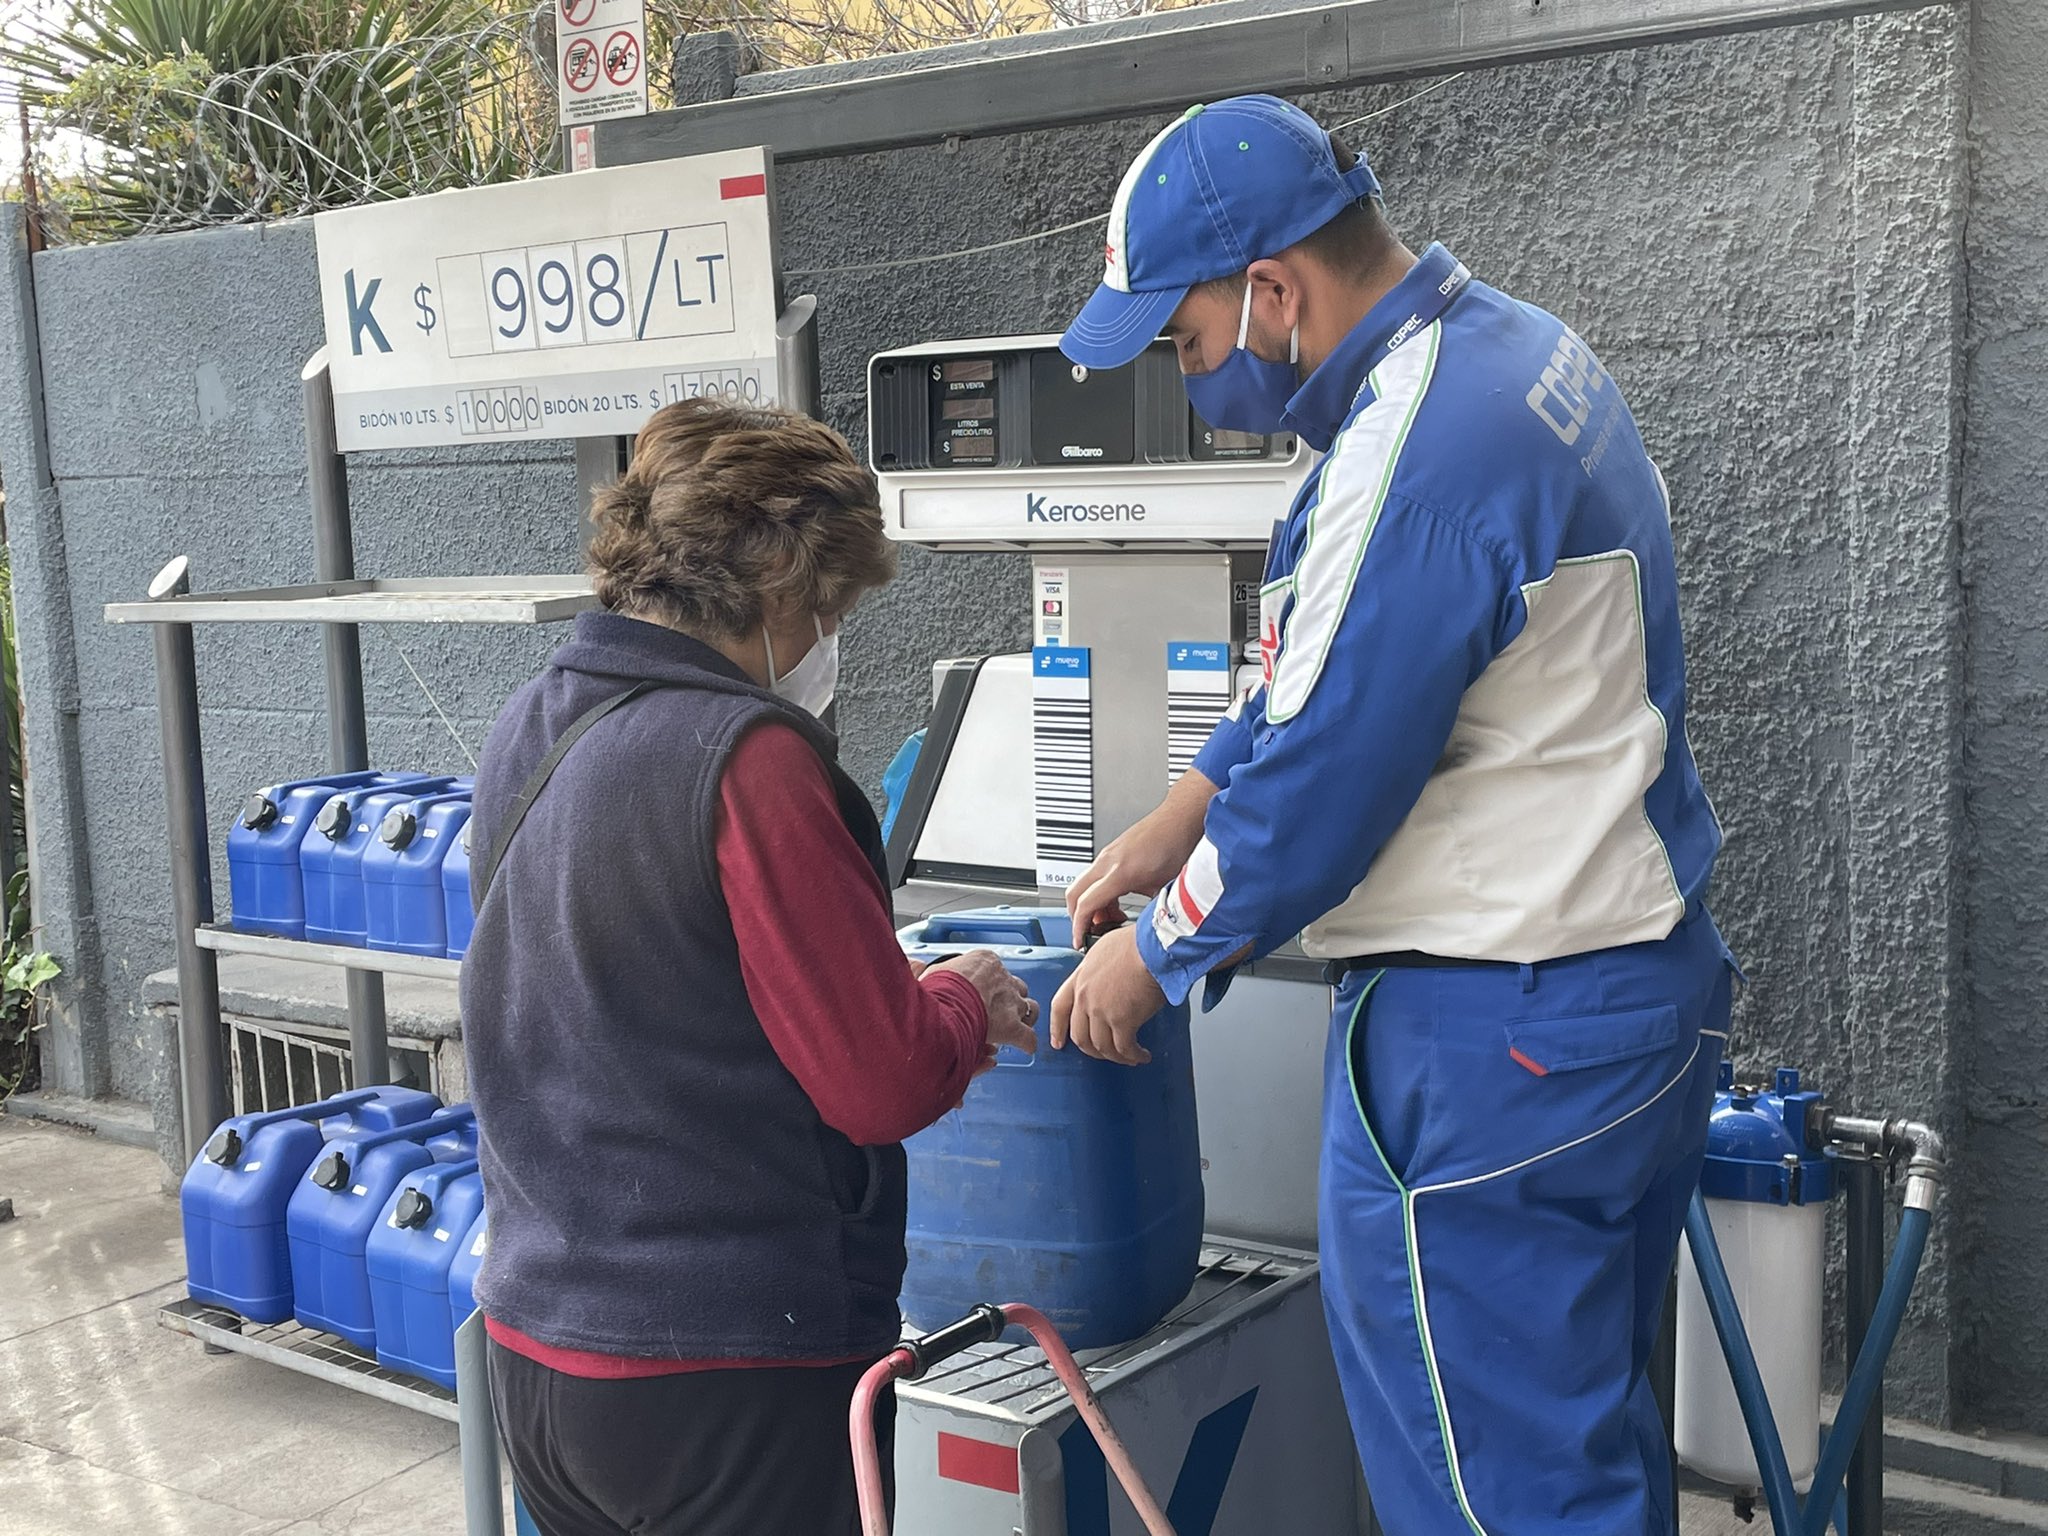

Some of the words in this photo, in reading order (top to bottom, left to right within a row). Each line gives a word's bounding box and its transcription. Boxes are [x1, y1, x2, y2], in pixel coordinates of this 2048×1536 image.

[343, 267, 394, 356] K
[414, 282, 437, 336] $
[1387, 313, 1423, 350] COPEC
[932, 364, 942, 381] $
[950, 382, 965, 390] ESTA
[965, 381, 985, 390] VENTA
[359, 407, 398, 429] BIDÓN
[399, 410, 413, 426] 10
[416, 408, 440, 425] LTS.
[445, 405, 455, 425] $
[461, 396, 539, 424] 10000
[544, 395, 589, 416] BIDÓN
[593, 396, 610, 412] 20
[614, 394, 643, 411] LTS.
[649, 389, 661, 410] $
[957, 420, 979, 428] LITROS
[951, 428, 993, 437] PRECIO/LITRO
[1204, 431, 1213, 445] $
[943, 440, 950, 453] $
[1061, 445, 1103, 457] Gilbarco
[1026, 492, 1146, 522] Kerosene
[1045, 586, 1061, 594] VISA
[1235, 584, 1247, 601] 26
[1054, 874, 1065, 882] 04
